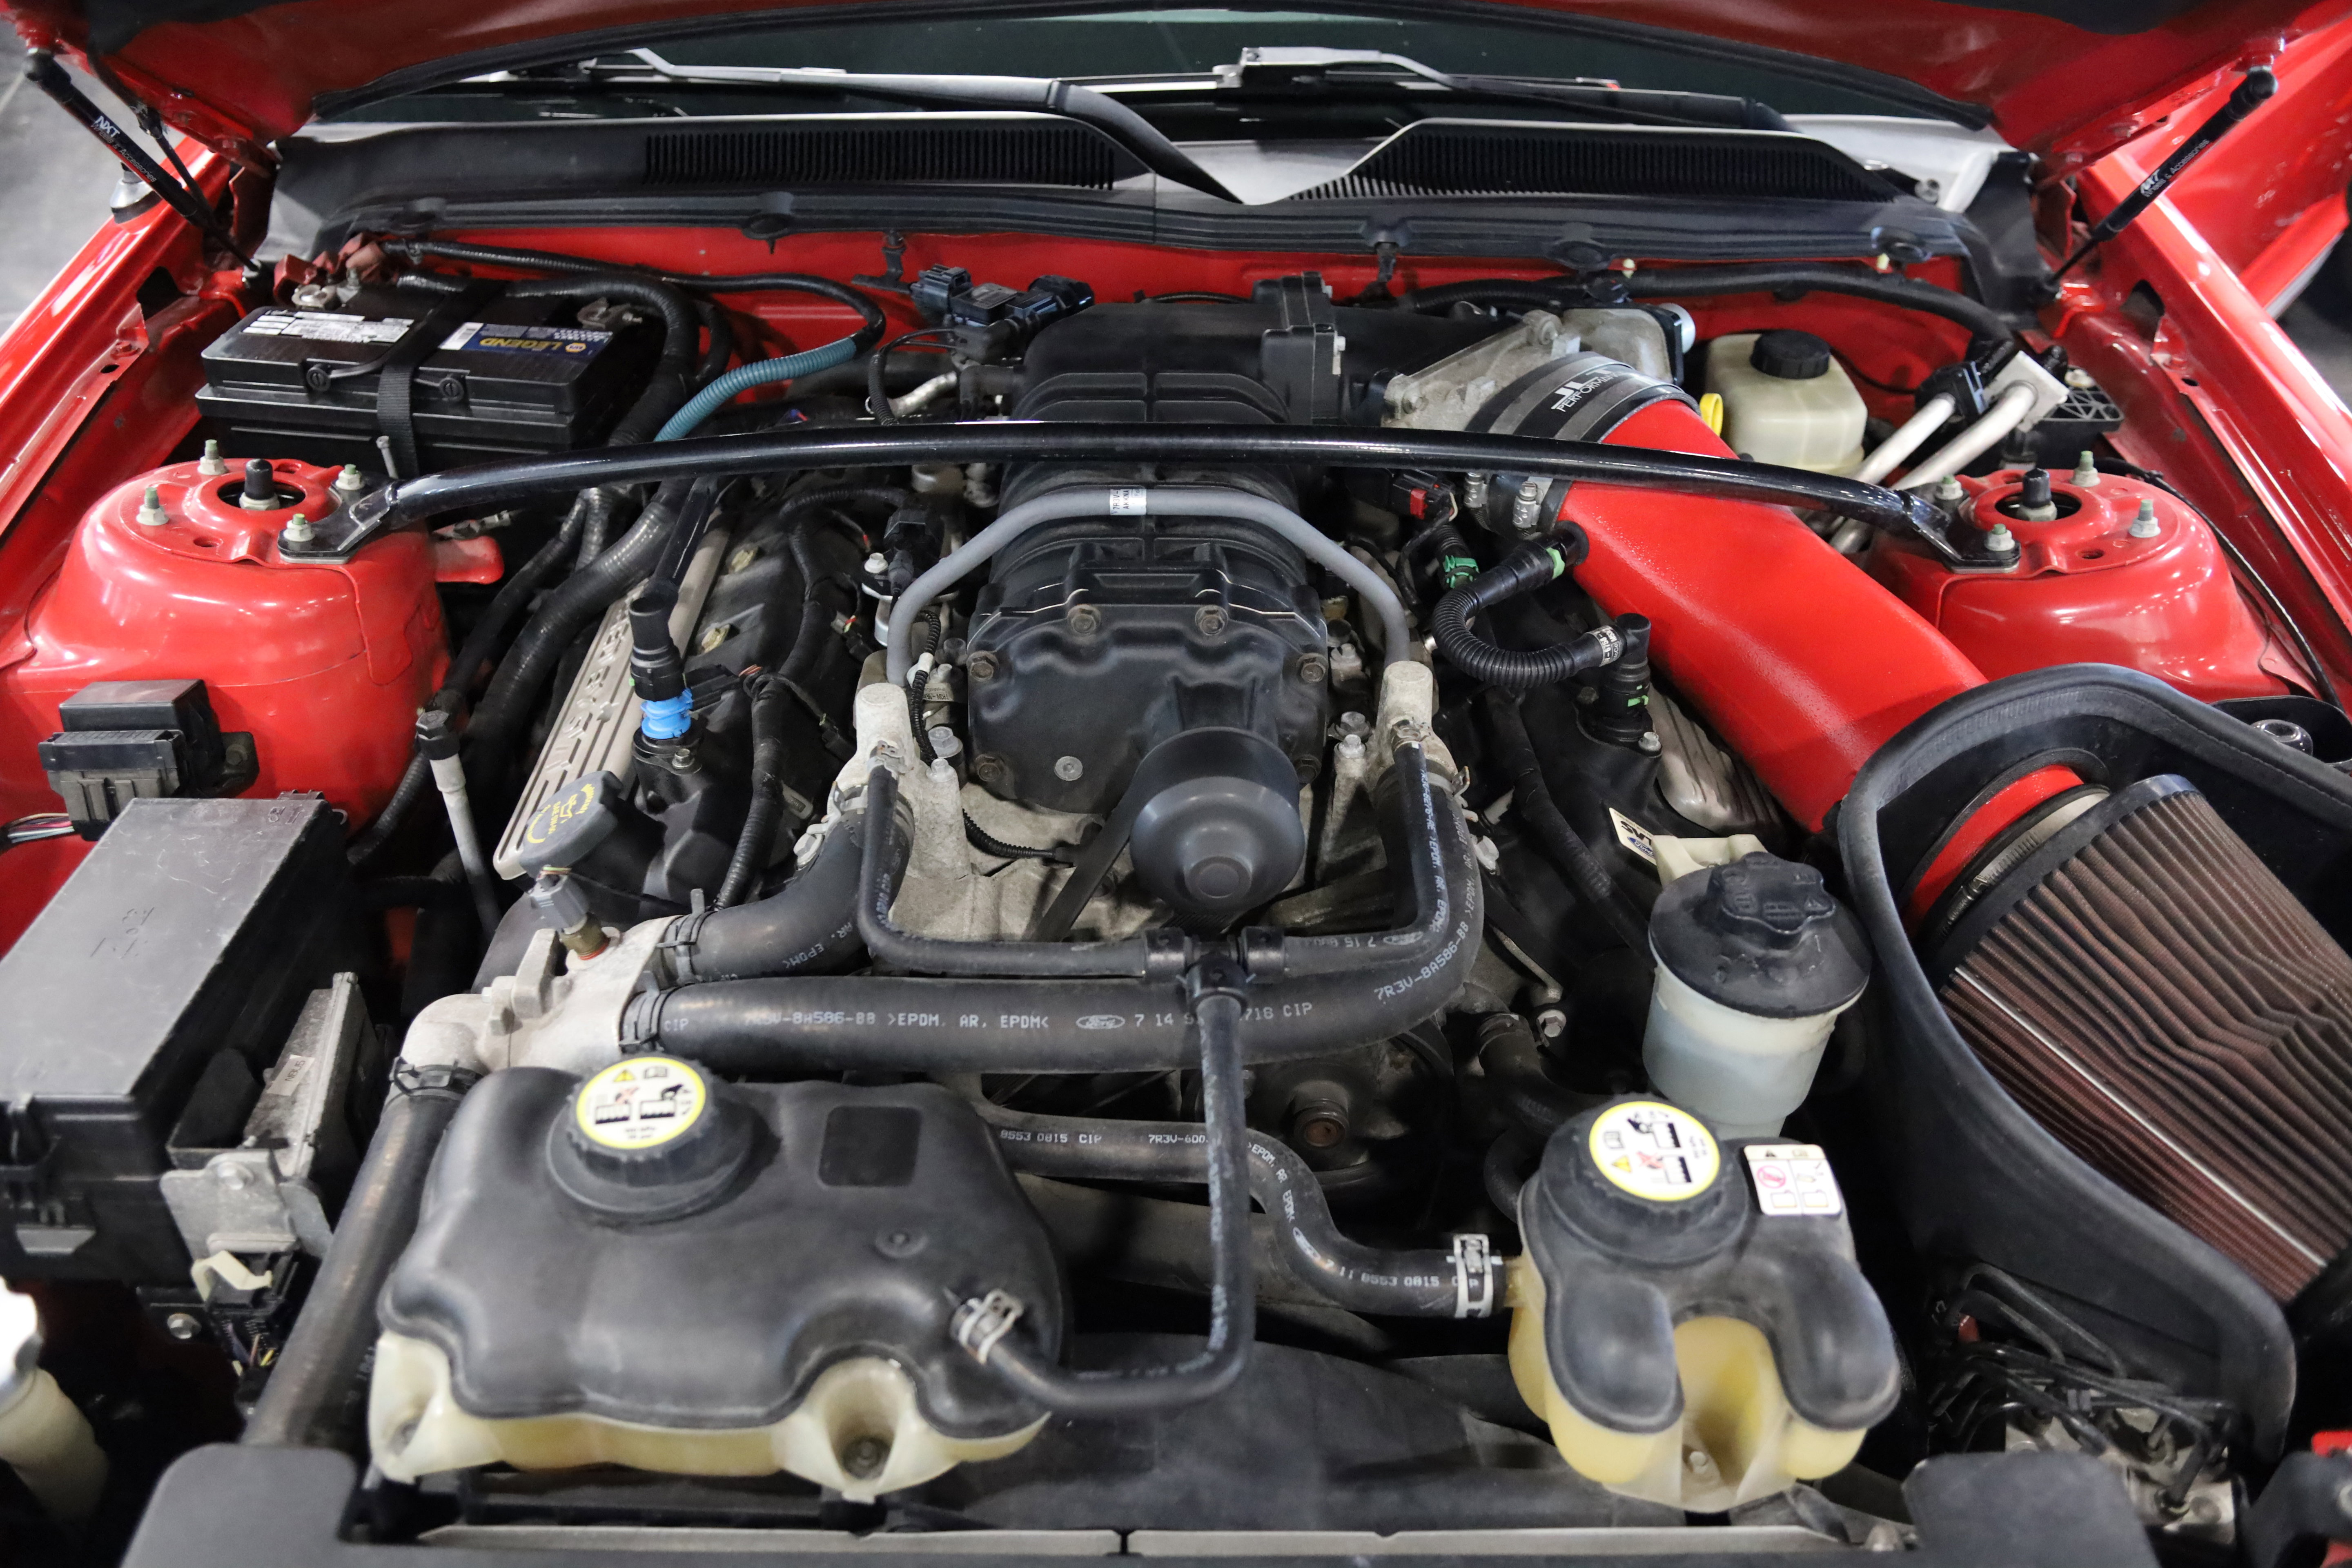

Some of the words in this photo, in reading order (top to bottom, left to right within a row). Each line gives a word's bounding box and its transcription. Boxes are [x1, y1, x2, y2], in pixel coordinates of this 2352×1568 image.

[94, 116, 120, 137] NXT
[479, 337, 563, 350] LEGEND
[1556, 372, 1619, 412] PERFORMAN
[664, 1019, 689, 1032] CIP
[1134, 1013, 1145, 1028] 7
[1156, 1013, 1174, 1027] 14
[1239, 1006, 1274, 1021] 718
[1283, 1002, 1313, 1017] CIP
[1451, 1275, 1479, 1288] CP
